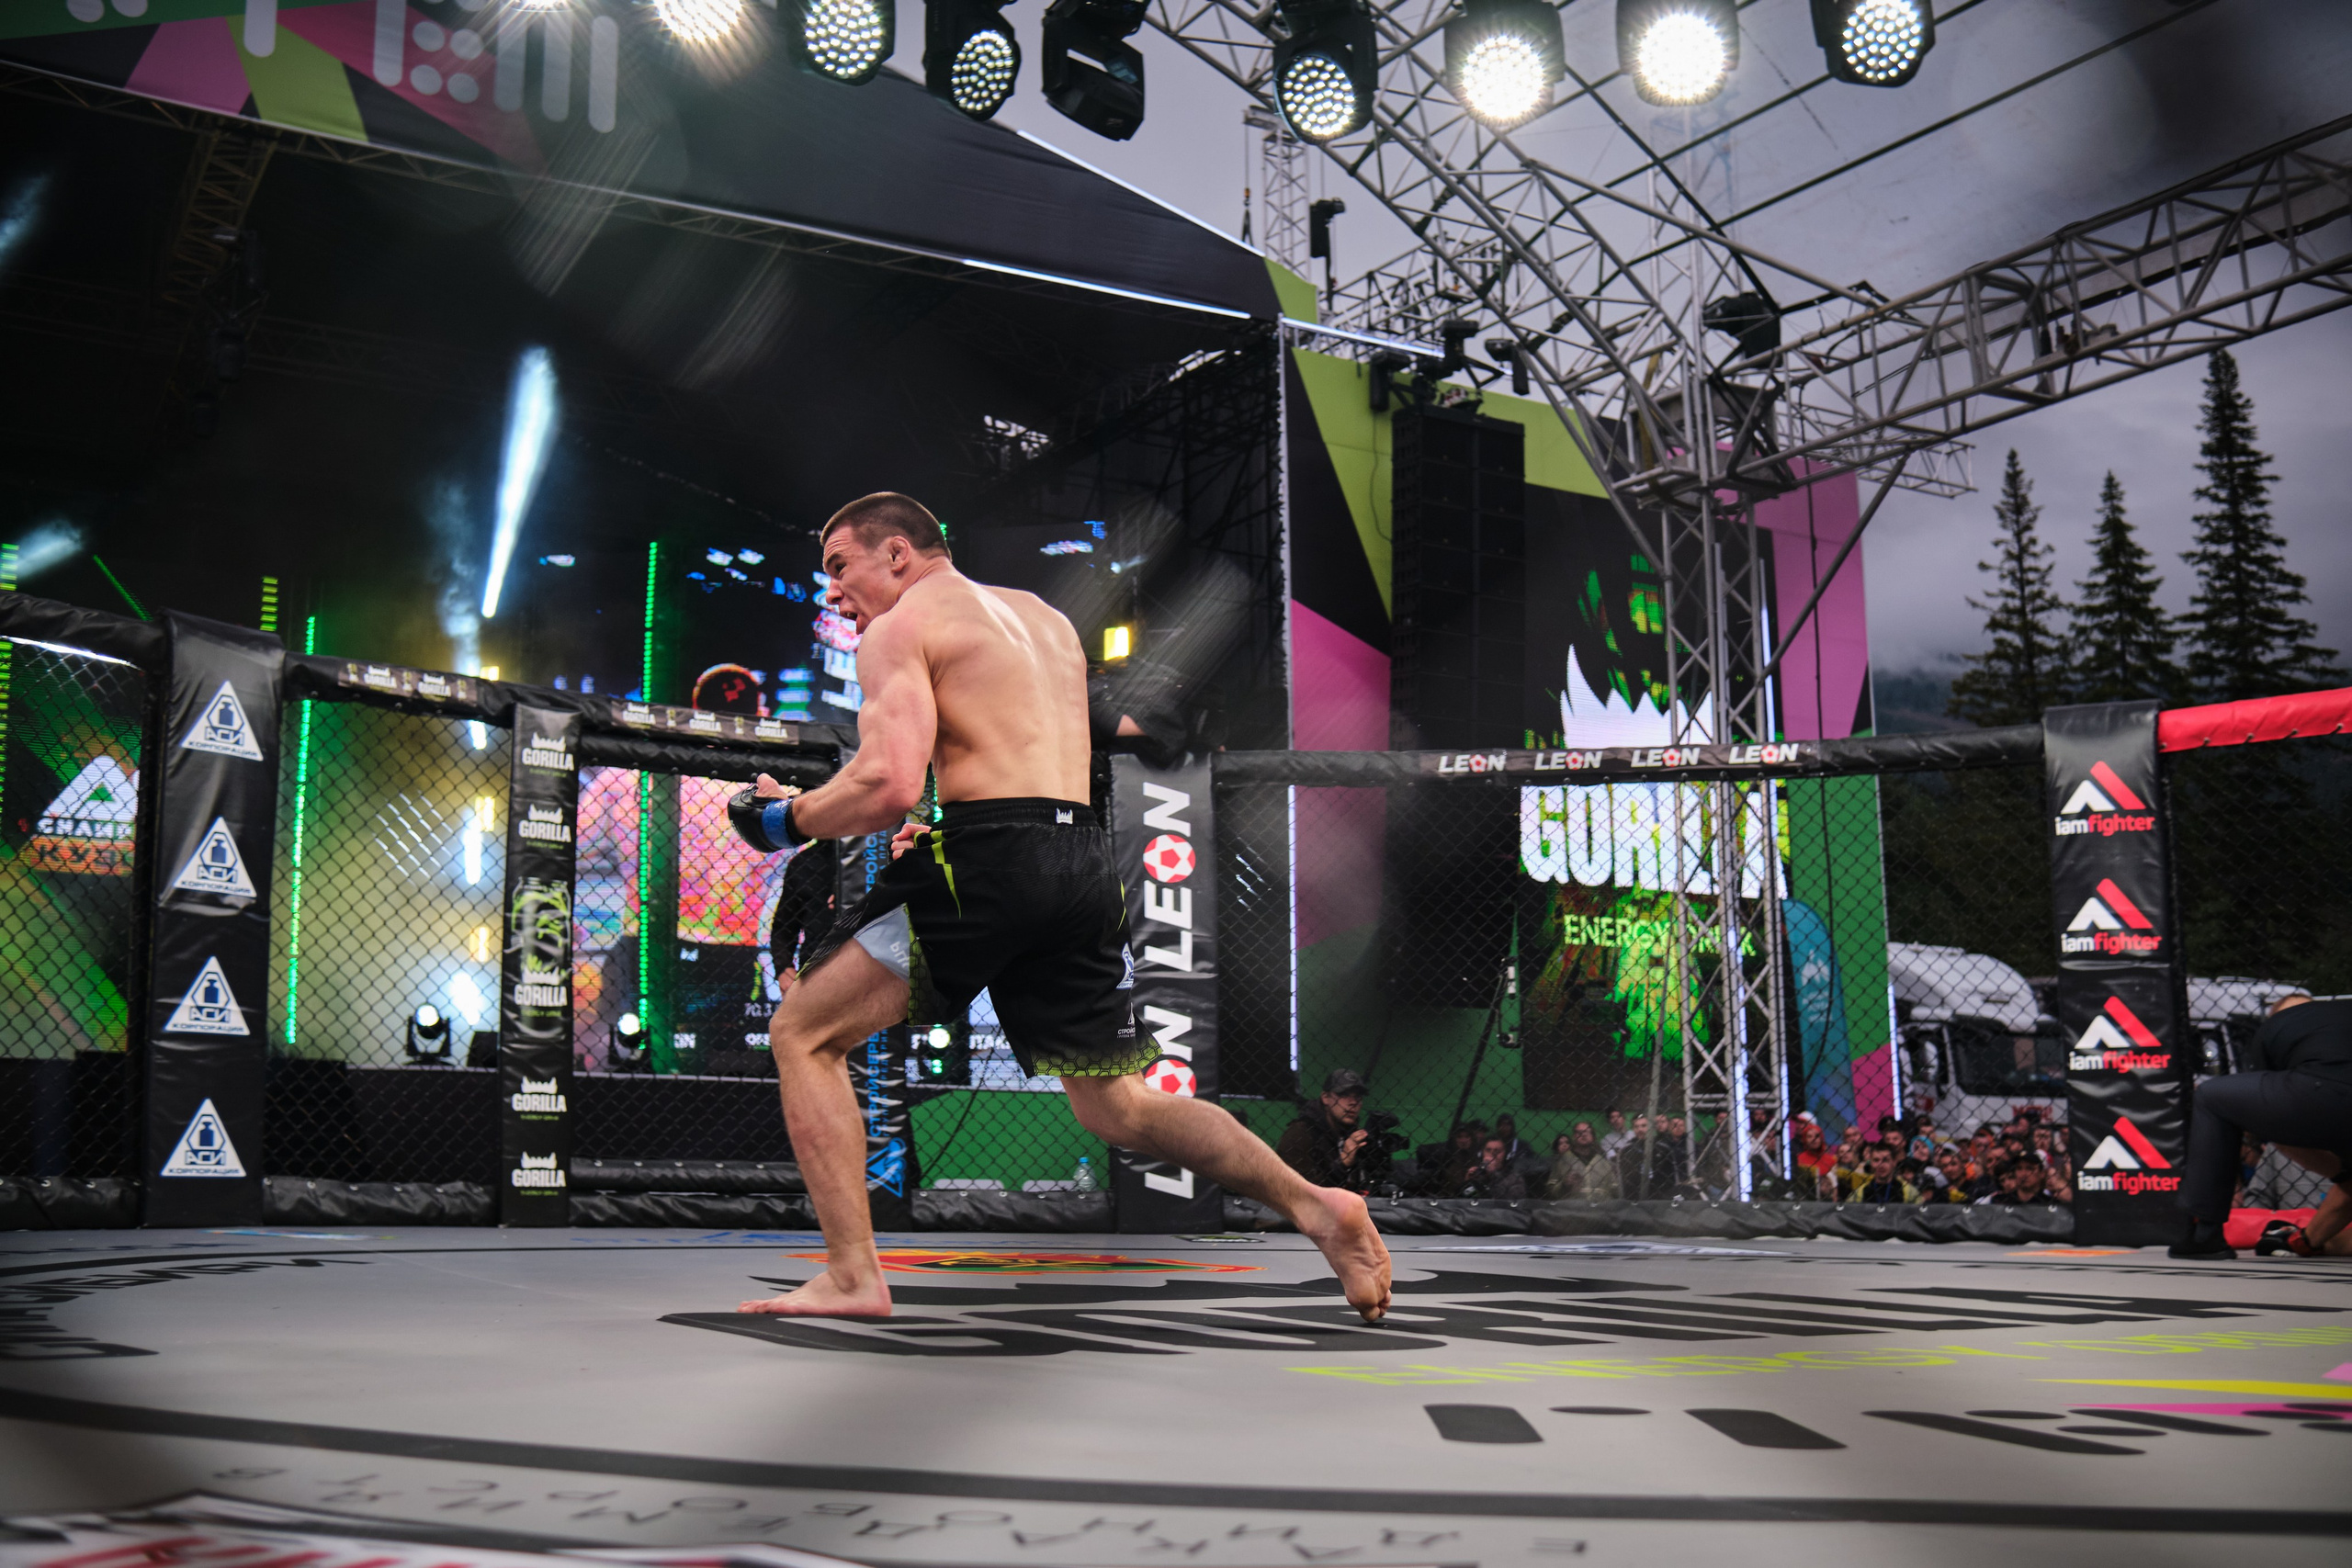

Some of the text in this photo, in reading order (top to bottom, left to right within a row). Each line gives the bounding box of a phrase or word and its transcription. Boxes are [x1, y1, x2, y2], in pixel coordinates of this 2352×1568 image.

[522, 747, 574, 771] GORILLA
[1438, 743, 1799, 773] LEON LEON LEON LEON
[518, 819, 571, 842] GORILLA
[2054, 814, 2155, 837] iamfighter
[1143, 782, 1196, 972] LEON
[1564, 914, 1670, 951] ENERGY
[2061, 932, 2162, 954] iamfighter
[514, 984, 567, 1006] GORILLA
[2069, 1050, 2171, 1073] iamfighter
[512, 1093, 567, 1112] GORILLA
[1144, 1005, 1197, 1199] LON
[512, 1168, 566, 1187] GORILLA
[2077, 1171, 2181, 1195] iamfighter
[656, 1287, 2352, 1356] GORILLA
[1283, 1345, 2049, 1386] ENERGY
